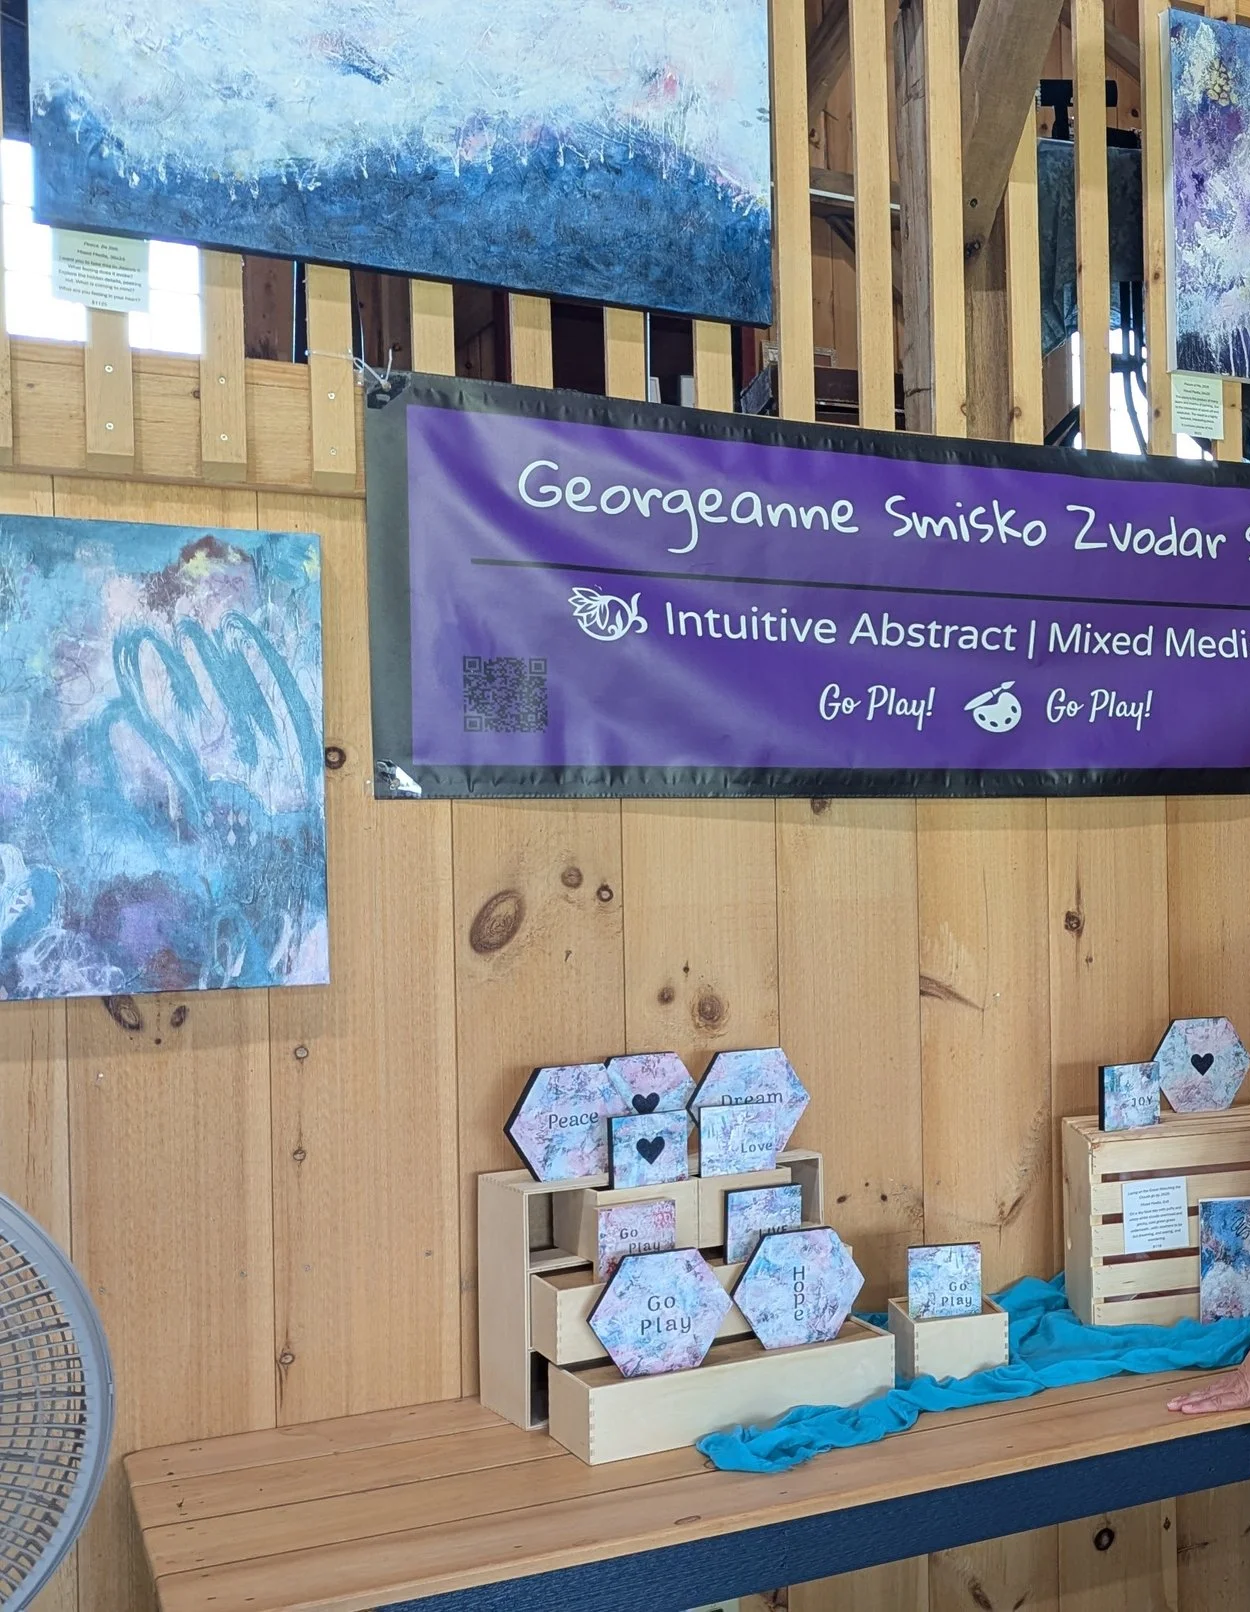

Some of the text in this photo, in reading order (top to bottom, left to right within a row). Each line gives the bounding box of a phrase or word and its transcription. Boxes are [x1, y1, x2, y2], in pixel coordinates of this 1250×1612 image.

[518, 460, 859, 554] Georgeanne
[885, 495, 1047, 547] Smisko
[1067, 504, 1225, 560] Zvodar
[665, 602, 837, 644] Intuitive
[849, 612, 1018, 652] Abstract
[1048, 623, 1153, 657] Mixed
[819, 683, 1155, 732] Go Play! Go Play!
[721, 1091, 783, 1106] Dream
[548, 1111, 599, 1130] Peace
[741, 1140, 773, 1154] Love
[620, 1228, 638, 1240] Go
[793, 1266, 805, 1322] Hope
[948, 1281, 969, 1292] Go
[648, 1295, 676, 1312] Go
[641, 1316, 692, 1336] Play
